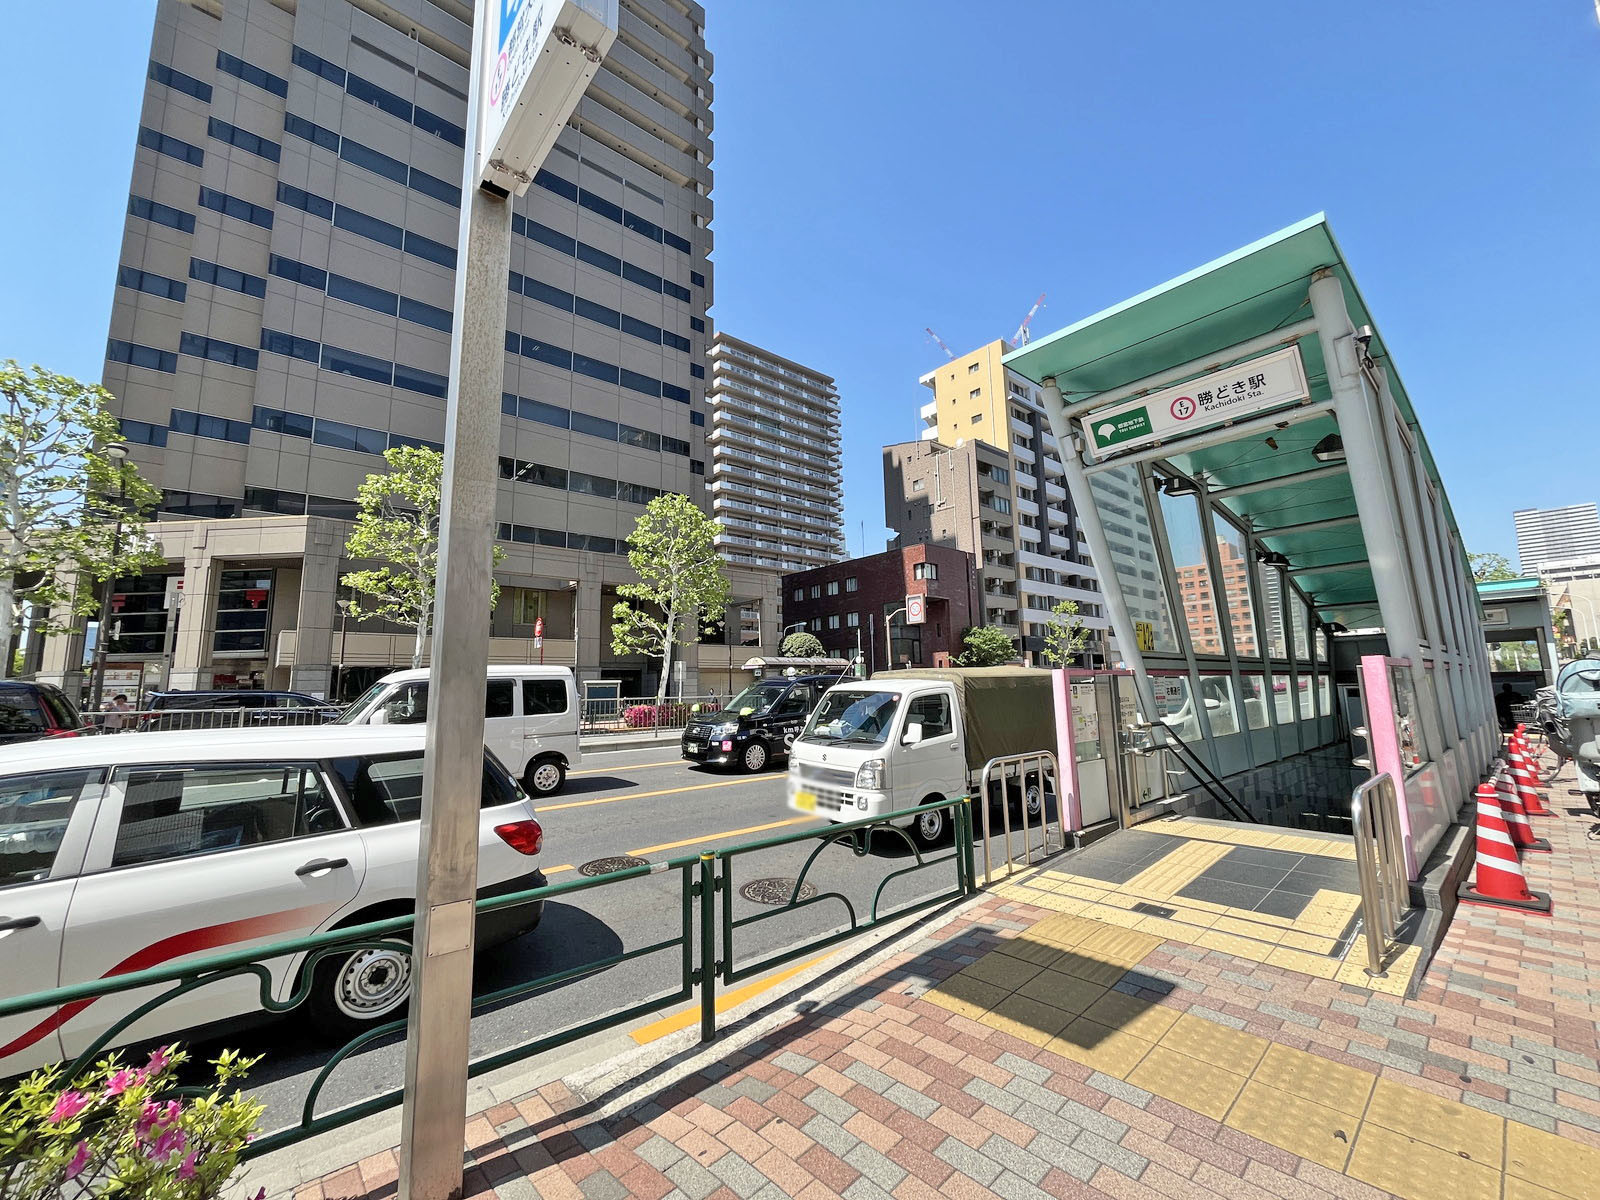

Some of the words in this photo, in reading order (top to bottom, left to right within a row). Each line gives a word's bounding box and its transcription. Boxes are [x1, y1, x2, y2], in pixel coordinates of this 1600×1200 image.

[1197, 373, 1266, 406] 勝どき駅
[1178, 406, 1189, 415] 17
[1205, 395, 1245, 411] Kachidoki
[1247, 390, 1264, 399] Sta.
